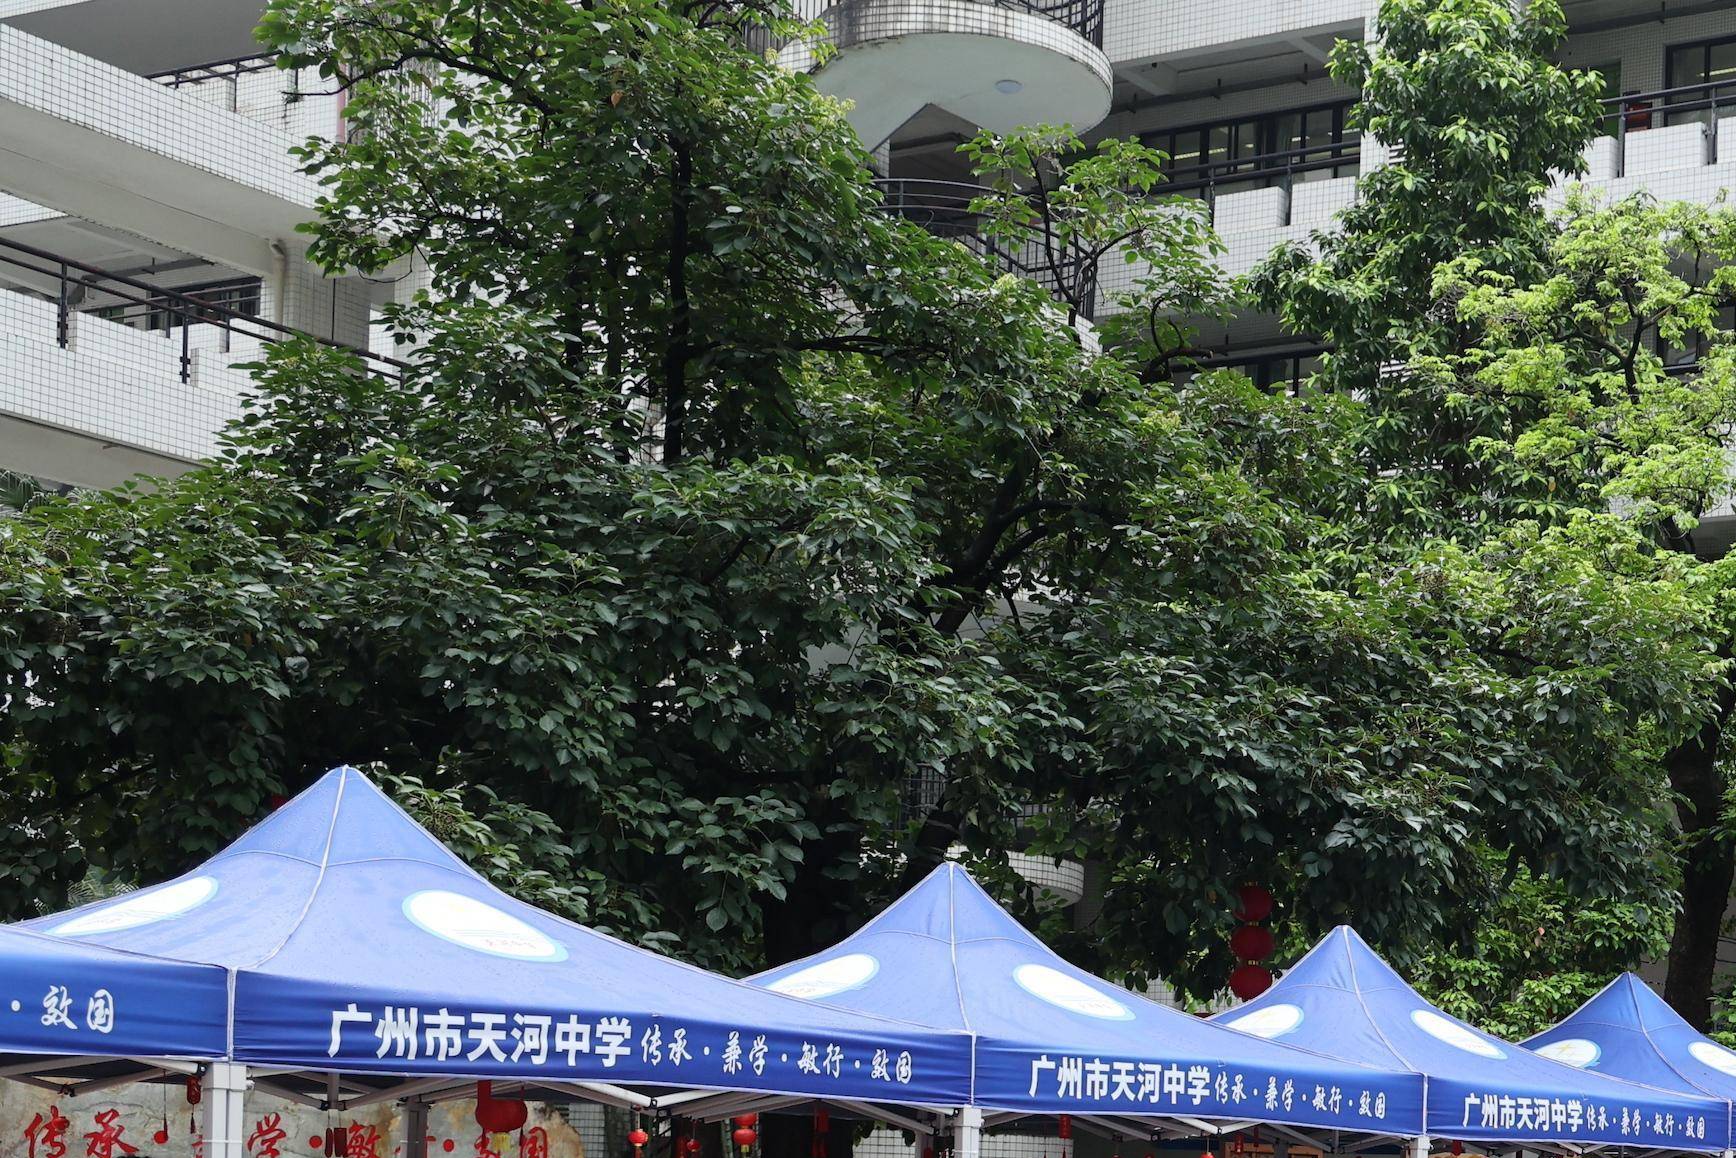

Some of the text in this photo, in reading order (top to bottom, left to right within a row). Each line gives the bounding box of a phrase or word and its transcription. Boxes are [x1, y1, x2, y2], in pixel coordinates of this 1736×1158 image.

[327, 1003, 633, 1067] 广州市天河中学
[1028, 1054, 1211, 1105] 广州市天河中学
[1462, 1093, 1584, 1133] 广州市天河中学
